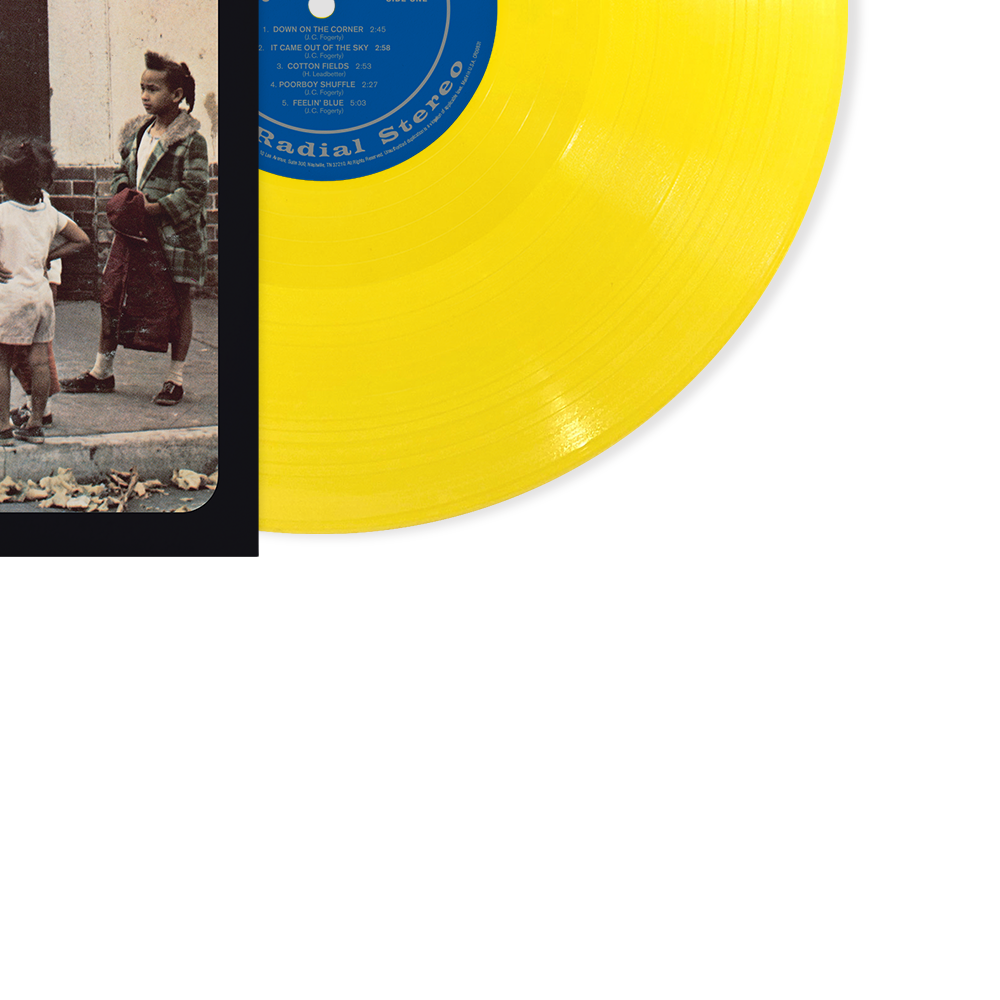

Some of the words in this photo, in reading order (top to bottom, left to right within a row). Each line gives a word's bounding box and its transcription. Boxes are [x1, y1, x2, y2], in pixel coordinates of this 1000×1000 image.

[273, 25, 298, 33] DOWN
[299, 25, 312, 33] ON
[313, 25, 329, 33] THE
[330, 25, 364, 33] CORNER
[369, 25, 387, 33] 2:45
[279, 44, 302, 52] CAME
[303, 44, 321, 52] OUT
[322, 44, 334, 52] OF
[335, 44, 351, 52] THE
[352, 44, 369, 52] SKY
[374, 44, 391, 52] 2:58
[287, 62, 320, 70] COTTON
[322, 62, 350, 70] FIELDS
[355, 62, 372, 70] 2:53
[278, 80, 319, 88] POORBOY
[320, 80, 356, 88] SHUFFLE
[323, 99, 344, 107] BLUE
[350, 99, 367, 107] 5:03
[258, 126, 366, 158] Radial
[378, 61, 463, 145] Stereo
